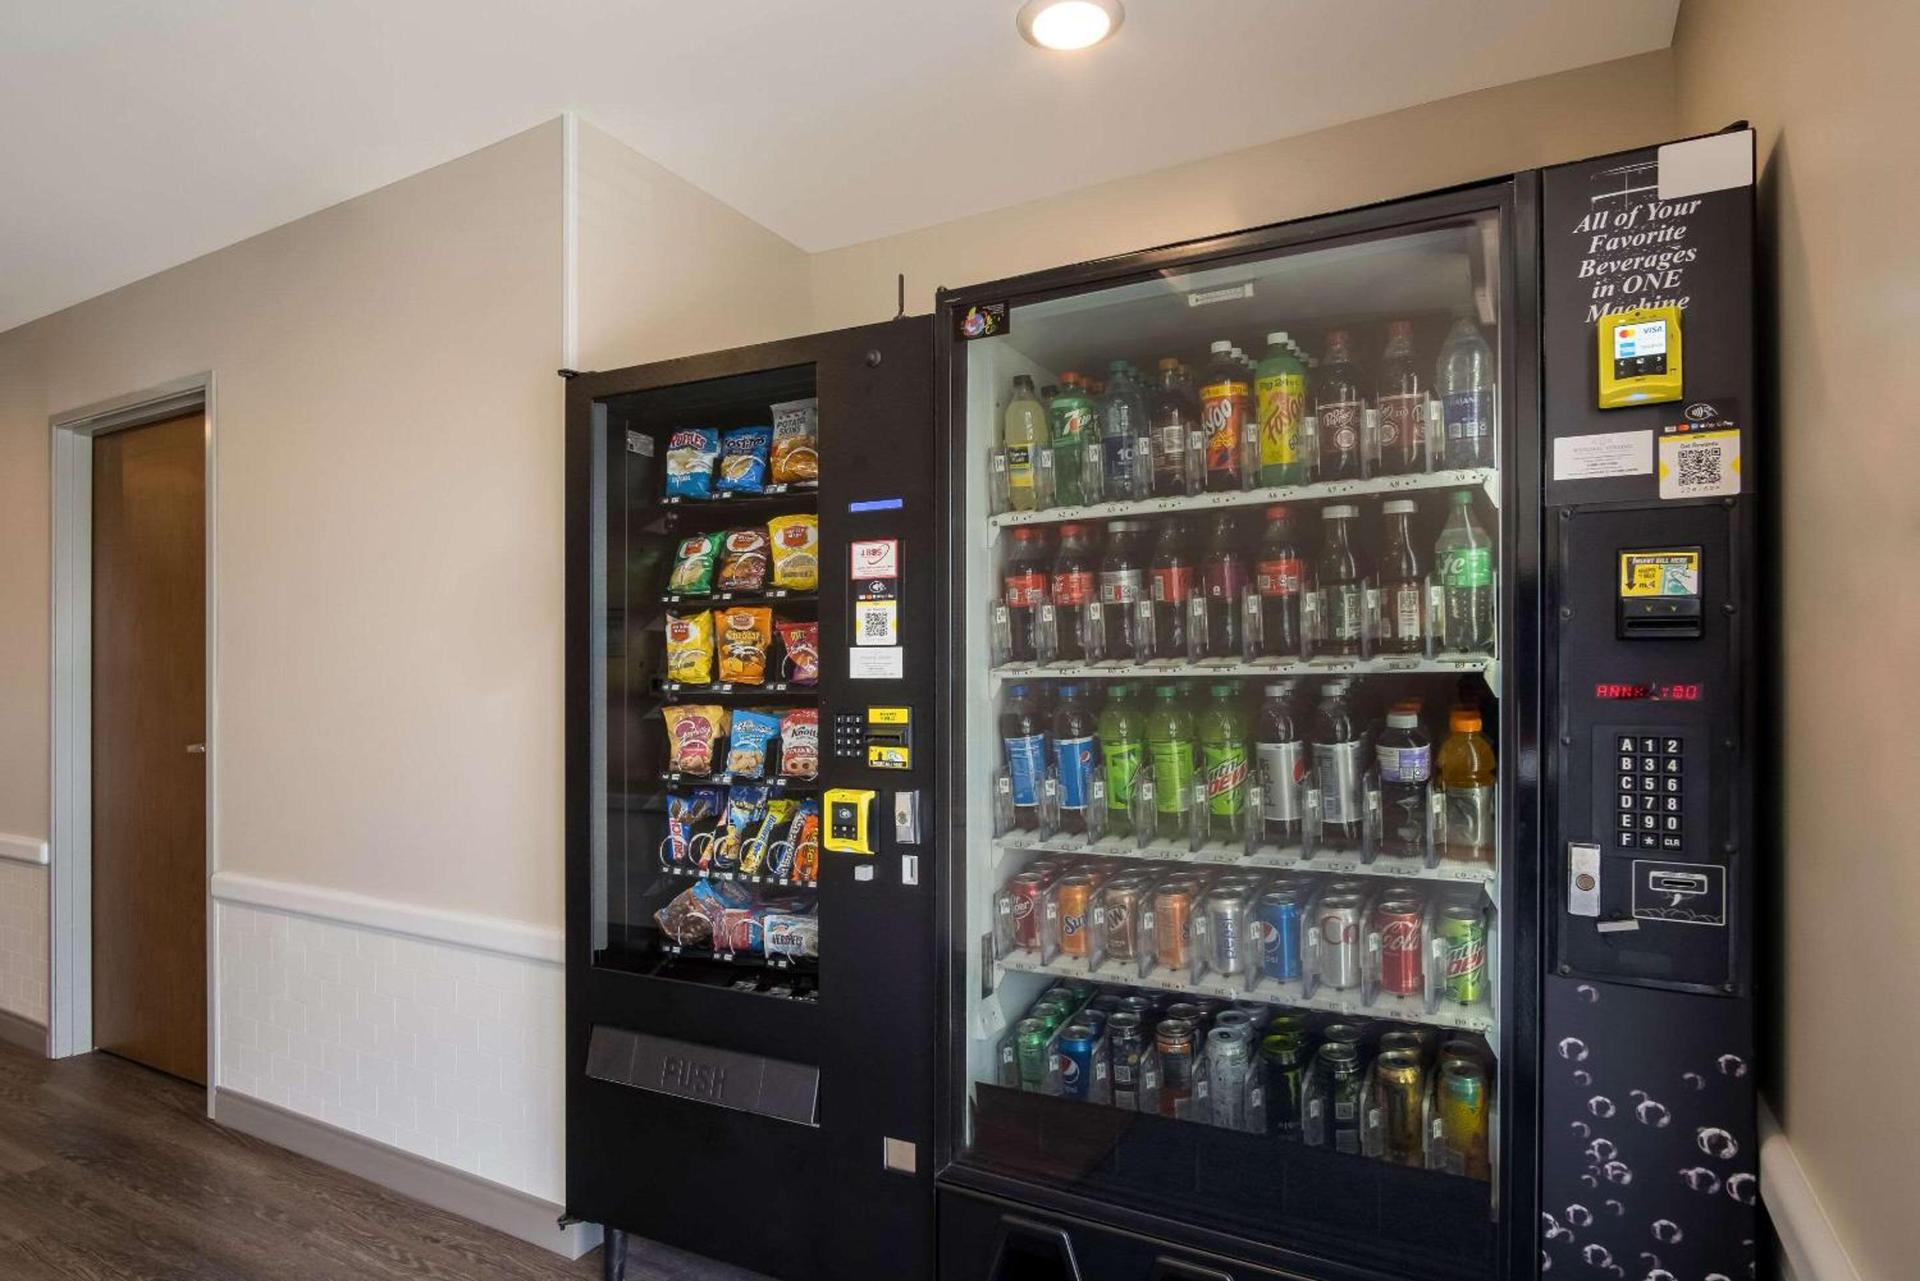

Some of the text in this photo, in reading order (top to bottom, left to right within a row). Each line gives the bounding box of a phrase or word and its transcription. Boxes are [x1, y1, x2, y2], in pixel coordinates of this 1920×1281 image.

[1572, 200, 1702, 234] All of Your
[1588, 225, 1687, 254] Favorite
[1578, 247, 1698, 279] Beverages
[1592, 269, 1683, 299] in ONE
[1643, 326, 1662, 334] VISA
[776, 417, 806, 429] POTATO
[779, 427, 801, 436] SKINS
[670, 431, 706, 449] RUFFLES
[1622, 738, 1677, 752] A 1 2
[1622, 758, 1678, 772] B 3 4
[1622, 776, 1677, 791] C 5 6
[1622, 795, 1677, 811] D 7 8
[1622, 815, 1677, 830] E 9 0
[1622, 833, 1680, 847] F CLR
[660, 1056, 727, 1099] PUSH
